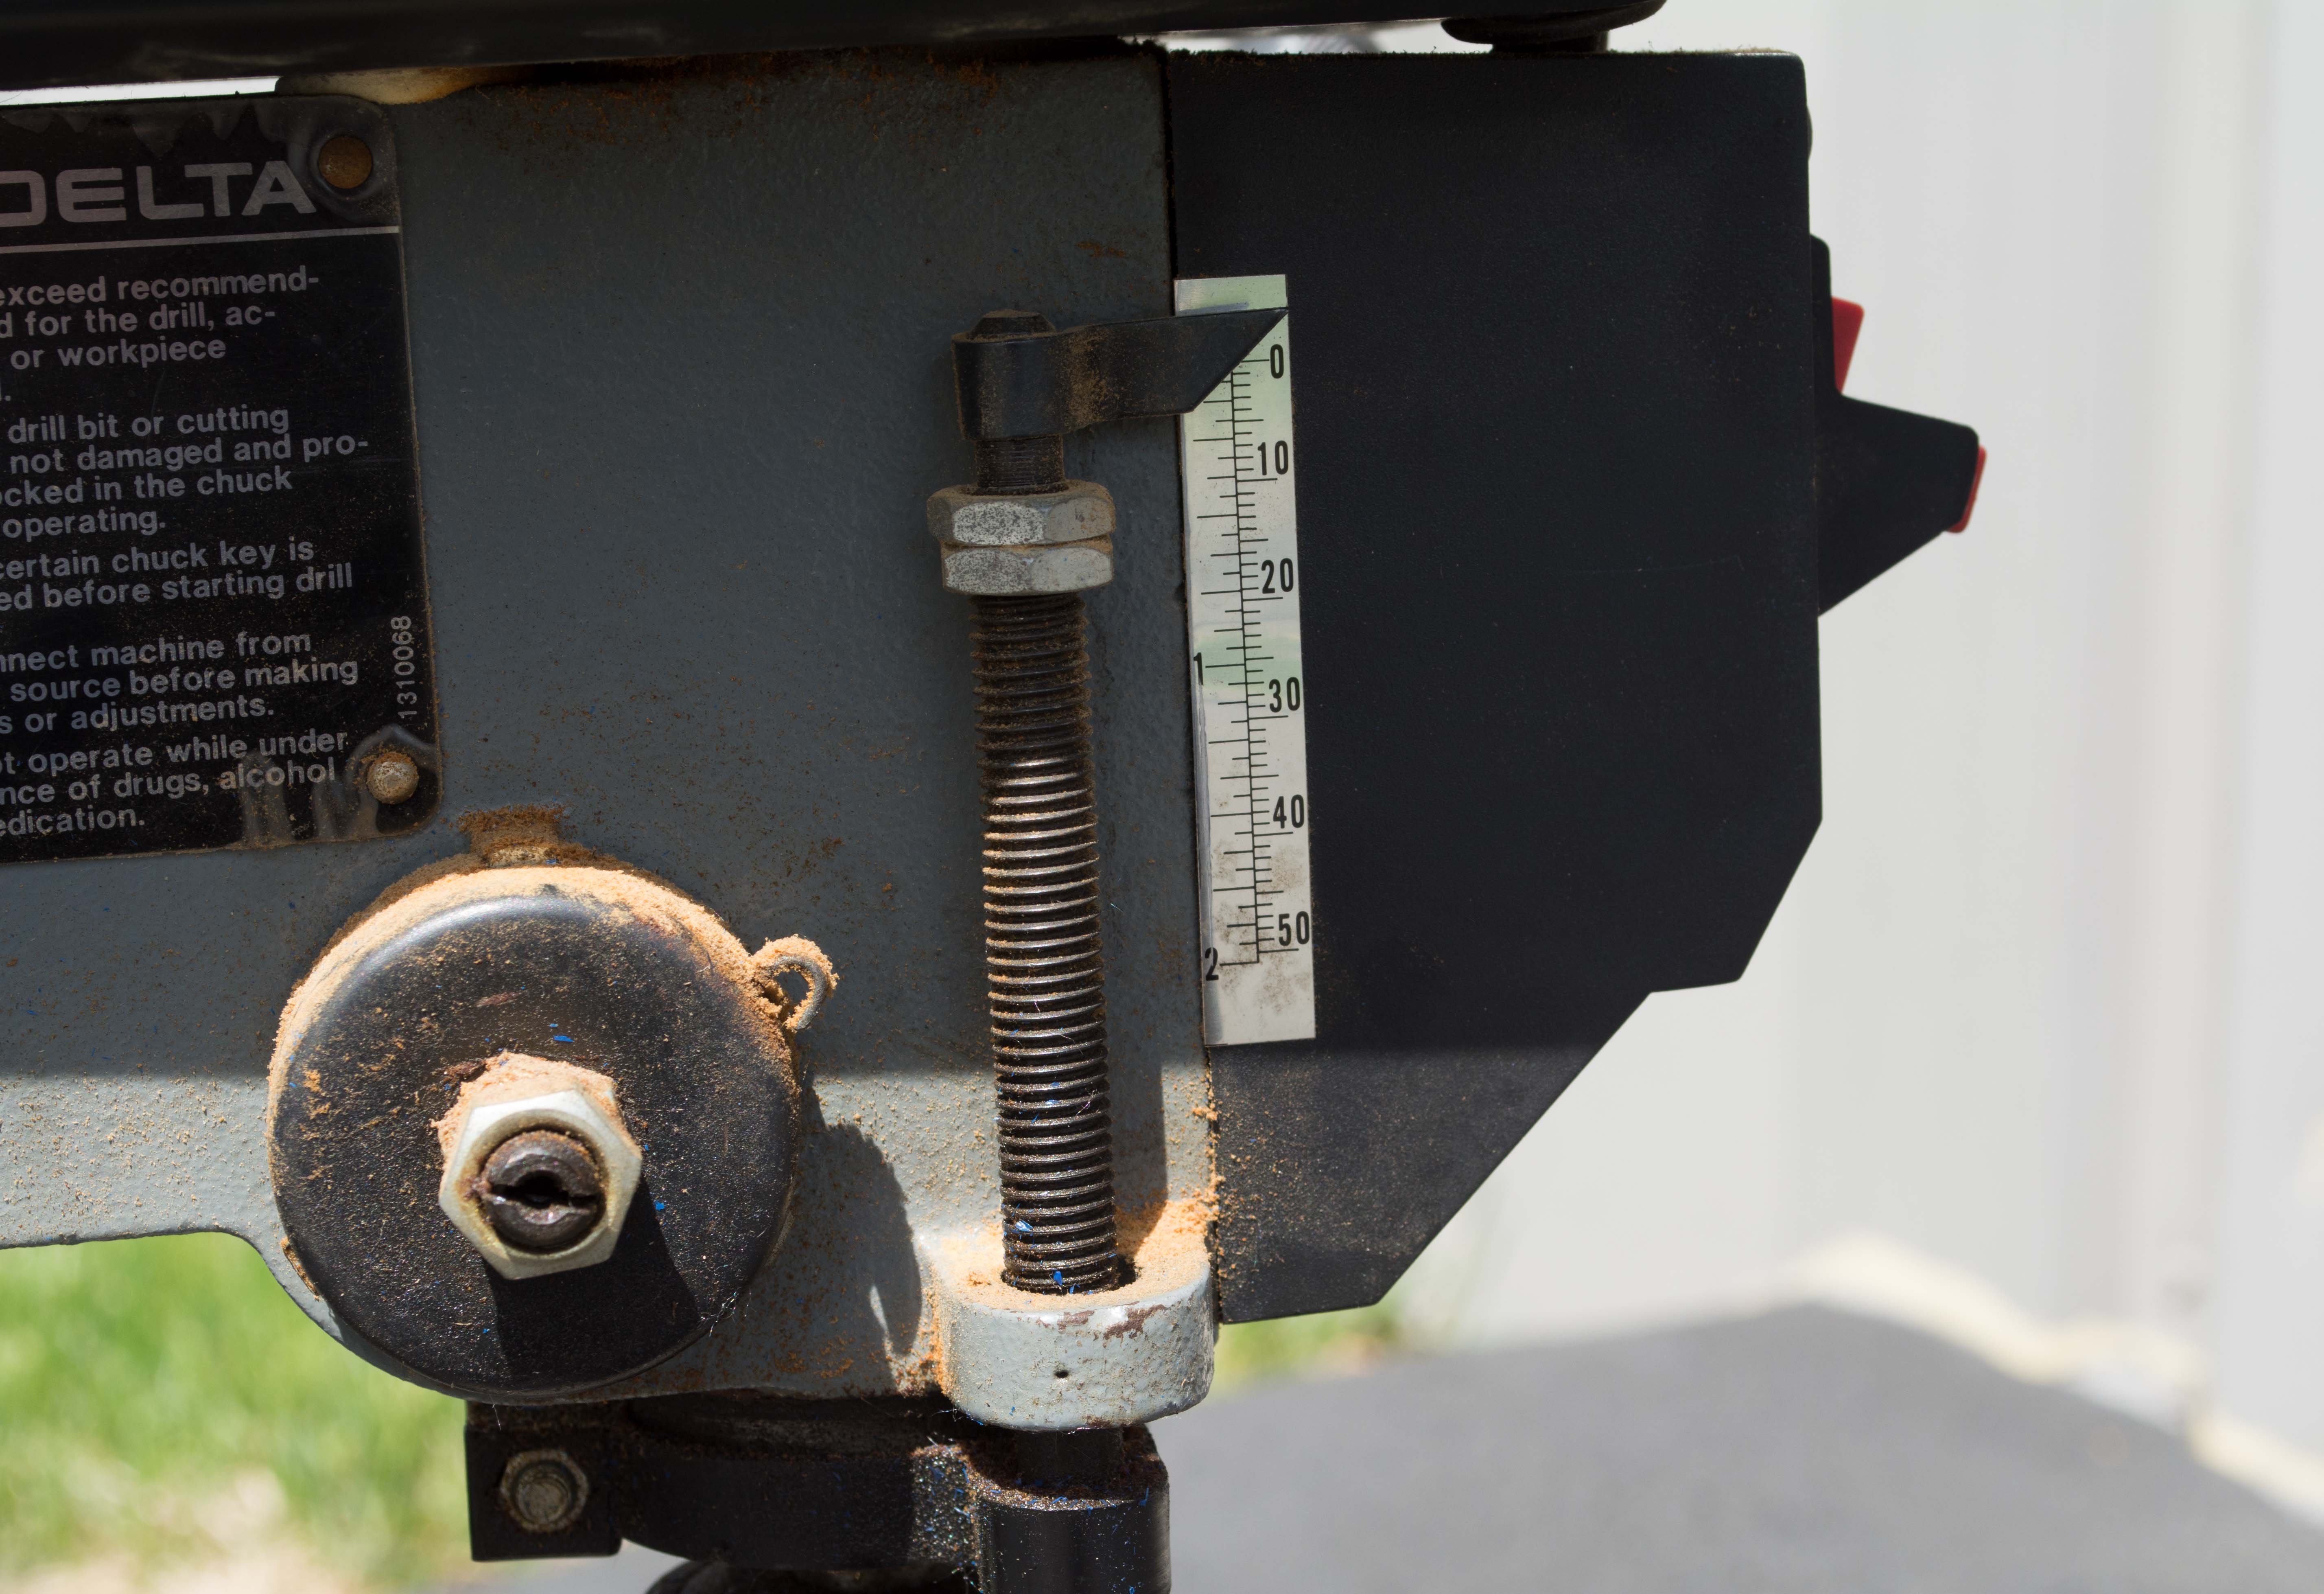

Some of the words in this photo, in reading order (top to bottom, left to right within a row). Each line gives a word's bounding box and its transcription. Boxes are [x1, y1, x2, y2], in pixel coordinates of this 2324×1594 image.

[0, 160, 316, 227] DELTA
[0, 276, 106, 306] xceed
[118, 265, 319, 300] recommend-
[25, 311, 71, 336] for
[85, 308, 137, 333] the
[149, 302, 214, 330] drill,
[226, 306, 275, 326] ac-
[11, 350, 44, 370] or
[57, 337, 225, 368] workpiece
[1270, 344, 1284, 379] 0
[8, 415, 66, 443] drill
[78, 413, 119, 440] bit
[132, 416, 164, 436] or
[177, 404, 289, 437] cutting
[10, 449, 64, 474] not
[77, 437, 222, 471] damaged
[234, 434, 291, 461] and
[303, 436, 368, 462] pro-
[1258, 440, 1288, 475] 10
[0, 477, 83, 506] cked
[95, 476, 122, 500] in
[134, 473, 185, 498] the
[197, 465, 292, 495] chuck
[2, 506, 165, 541] operating.
[0, 550, 99, 579] ertain
[112, 543, 208, 573] chuck
[220, 541, 275, 569] key
[289, 536, 314, 561] is
[43, 579, 150, 607] before
[162, 570, 284, 599] starting
[296, 563, 352, 590] drill
[1261, 558, 1293, 593] 20
[92, 635, 224, 666] machine
[236, 631, 310, 656] from
[11, 678, 120, 702] source
[130, 666, 235, 694] before
[245, 657, 358, 686] making
[390, 616, 417, 718] 1310068
[1193, 653, 1203, 684] 1
[1269, 677, 1300, 712] 30
[25, 713, 57, 732] or
[72, 698, 273, 731] adjustments.
[0, 752, 15, 774] t
[28, 744, 153, 776] operate
[166, 734, 247, 763] while
[256, 729, 347, 755] under
[68, 774, 100, 800] of
[114, 772, 209, 799] drugs,
[219, 754, 336, 789] alcohol
[1273, 795, 1304, 828] 40
[1279, 911, 1310, 946] 50
[1204, 948, 1218, 982] 2
